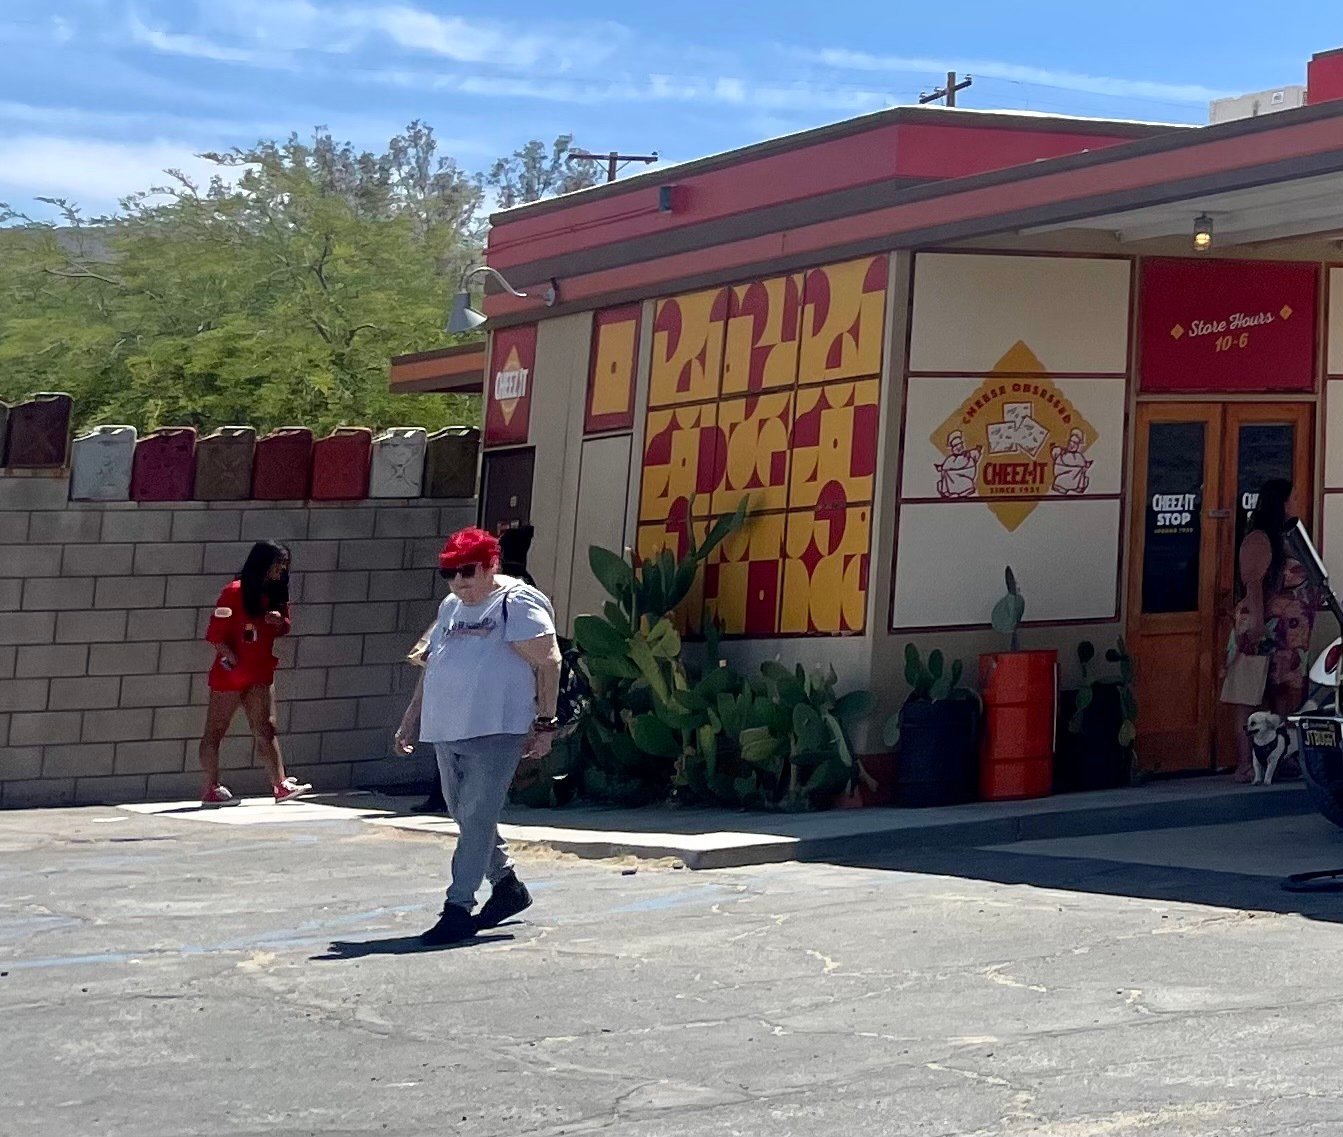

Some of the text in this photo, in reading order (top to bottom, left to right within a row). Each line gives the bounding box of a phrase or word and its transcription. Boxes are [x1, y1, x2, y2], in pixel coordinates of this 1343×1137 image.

[1188, 311, 1275, 338] Store Hours
[1215, 332, 1249, 353] 10-6
[962, 382, 1073, 425] CHEESE OBSESSED
[1156, 512, 1192, 526] STOP
